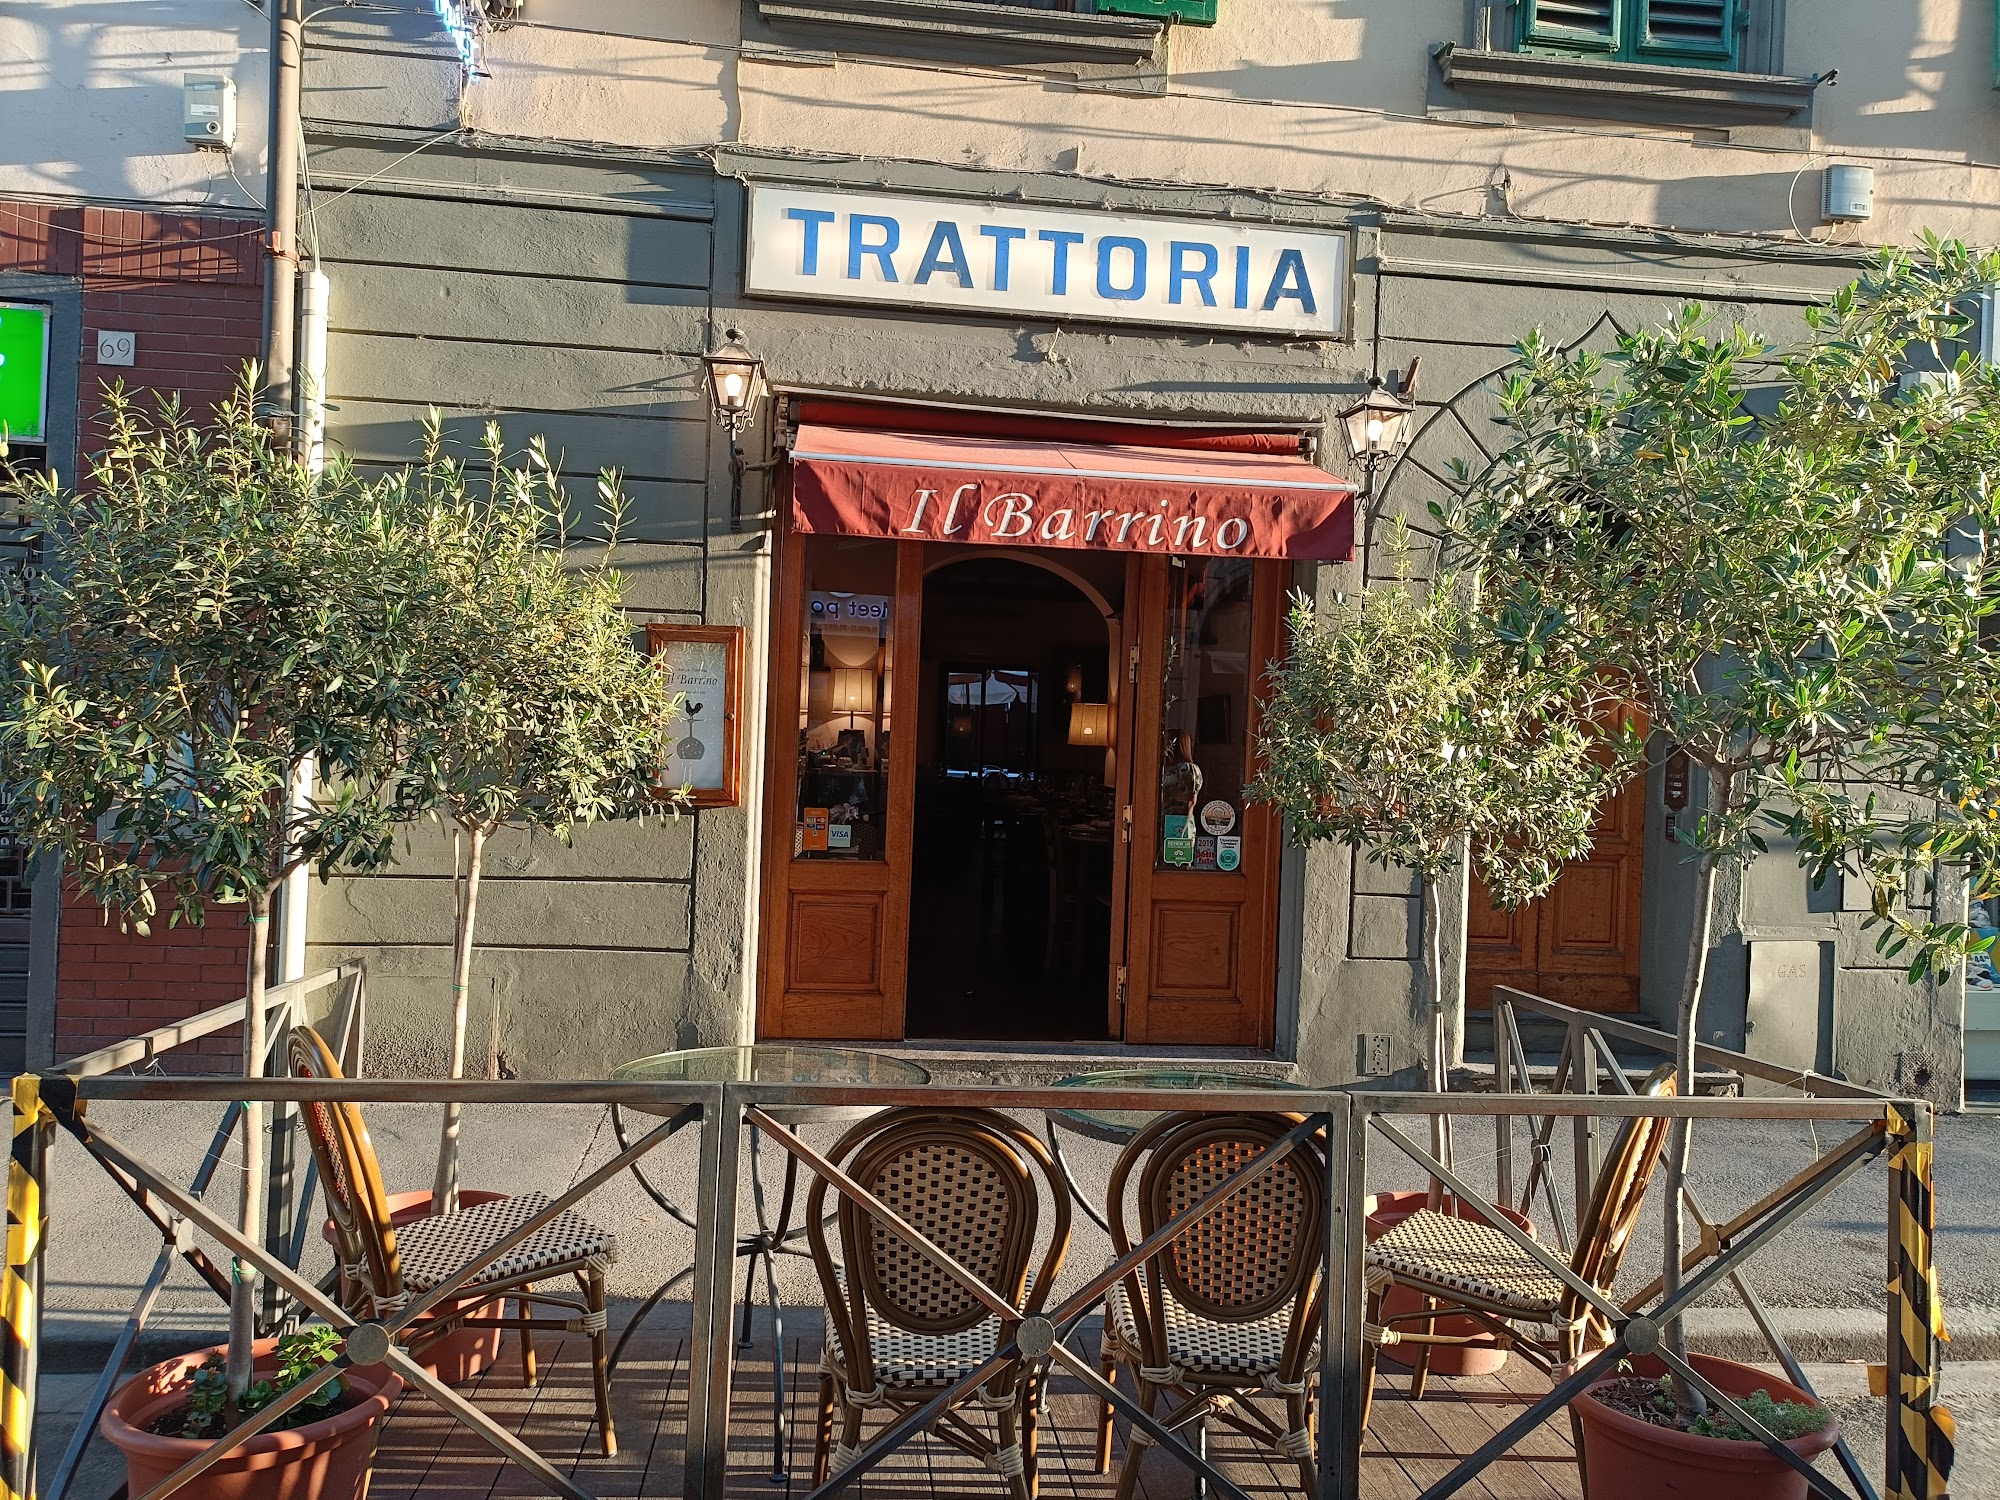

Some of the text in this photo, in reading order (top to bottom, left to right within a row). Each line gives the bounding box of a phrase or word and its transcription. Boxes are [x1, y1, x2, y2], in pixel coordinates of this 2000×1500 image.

[787, 208, 1318, 315] TRATTORIA
[100, 338, 131, 358] 69
[902, 483, 1248, 549] Il Barrino
[677, 674, 718, 686] Barrino
[1198, 839, 1214, 847] 2019
[1777, 964, 1807, 978] GAS
